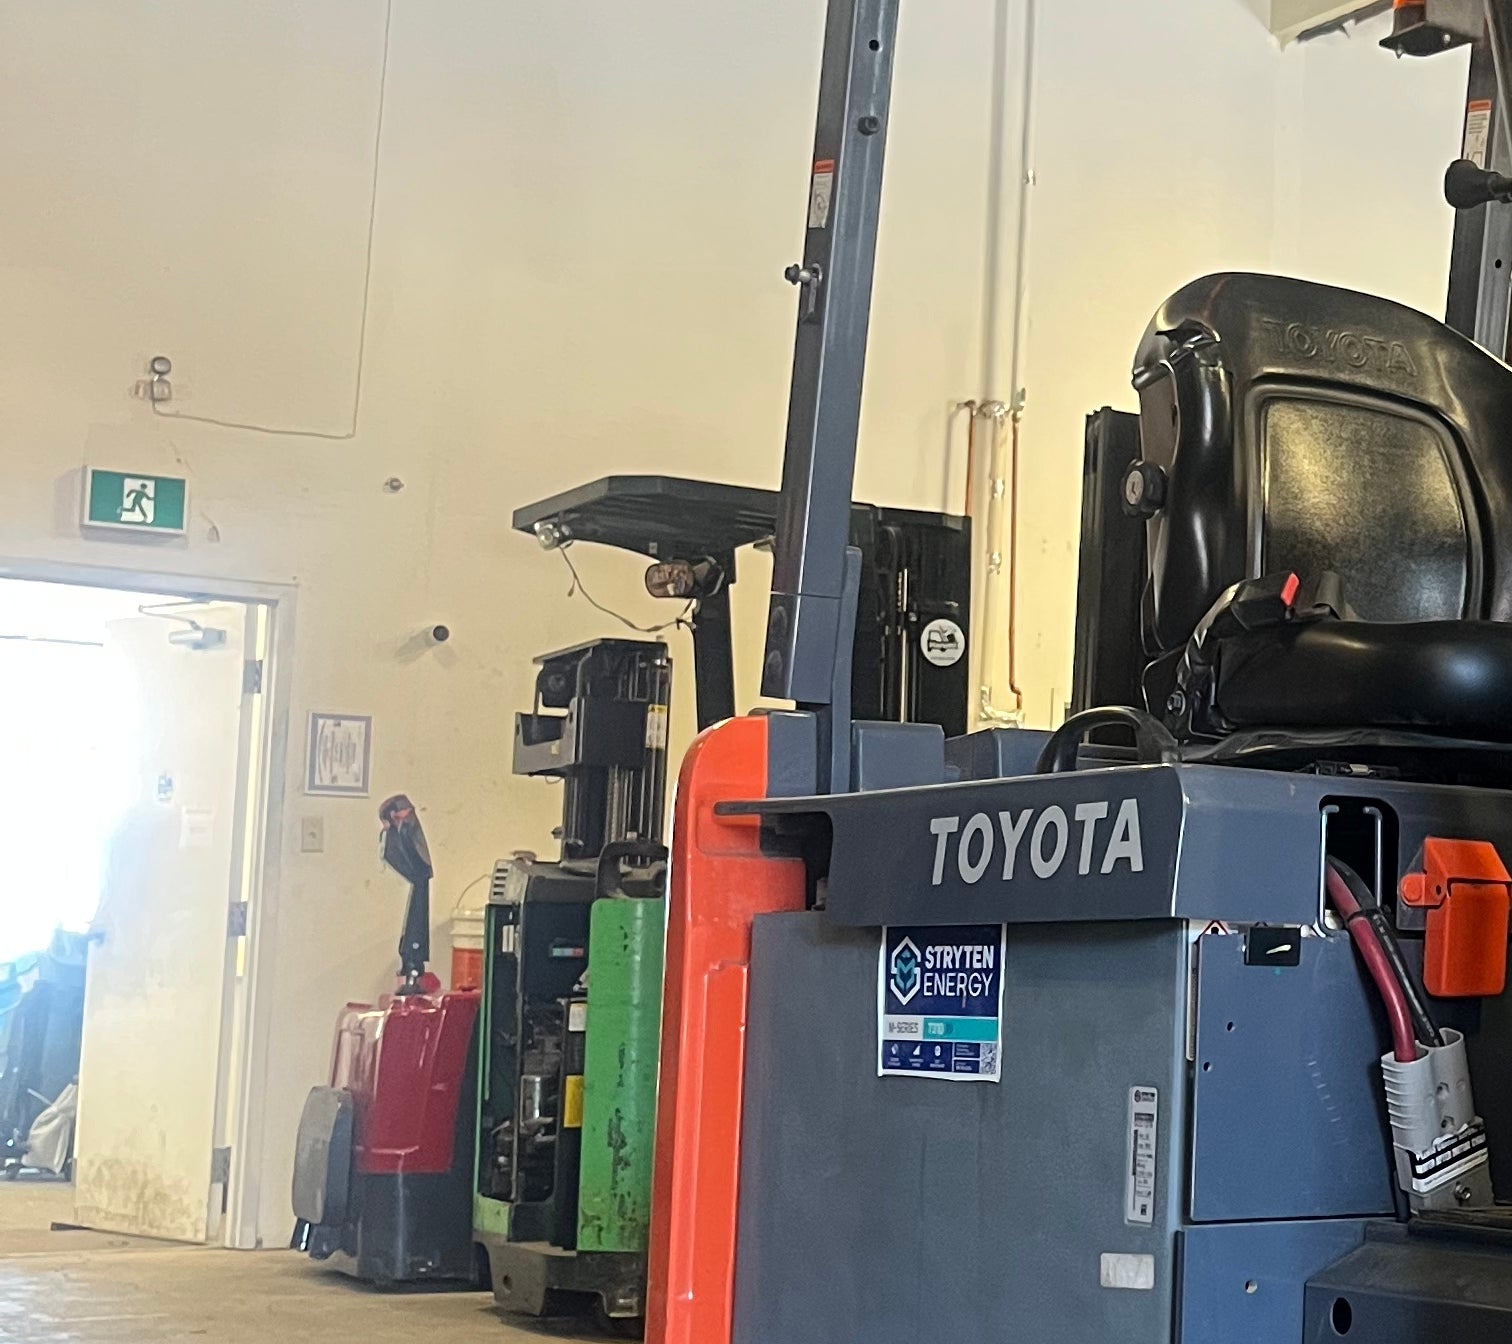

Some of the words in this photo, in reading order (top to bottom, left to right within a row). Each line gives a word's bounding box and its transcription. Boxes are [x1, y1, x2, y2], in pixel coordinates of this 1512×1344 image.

[1262, 318, 1418, 377] TOYOTA
[930, 799, 1144, 885] TOYOTA
[924, 945, 995, 969] STRYTEN
[923, 972, 994, 997] ENERGY
